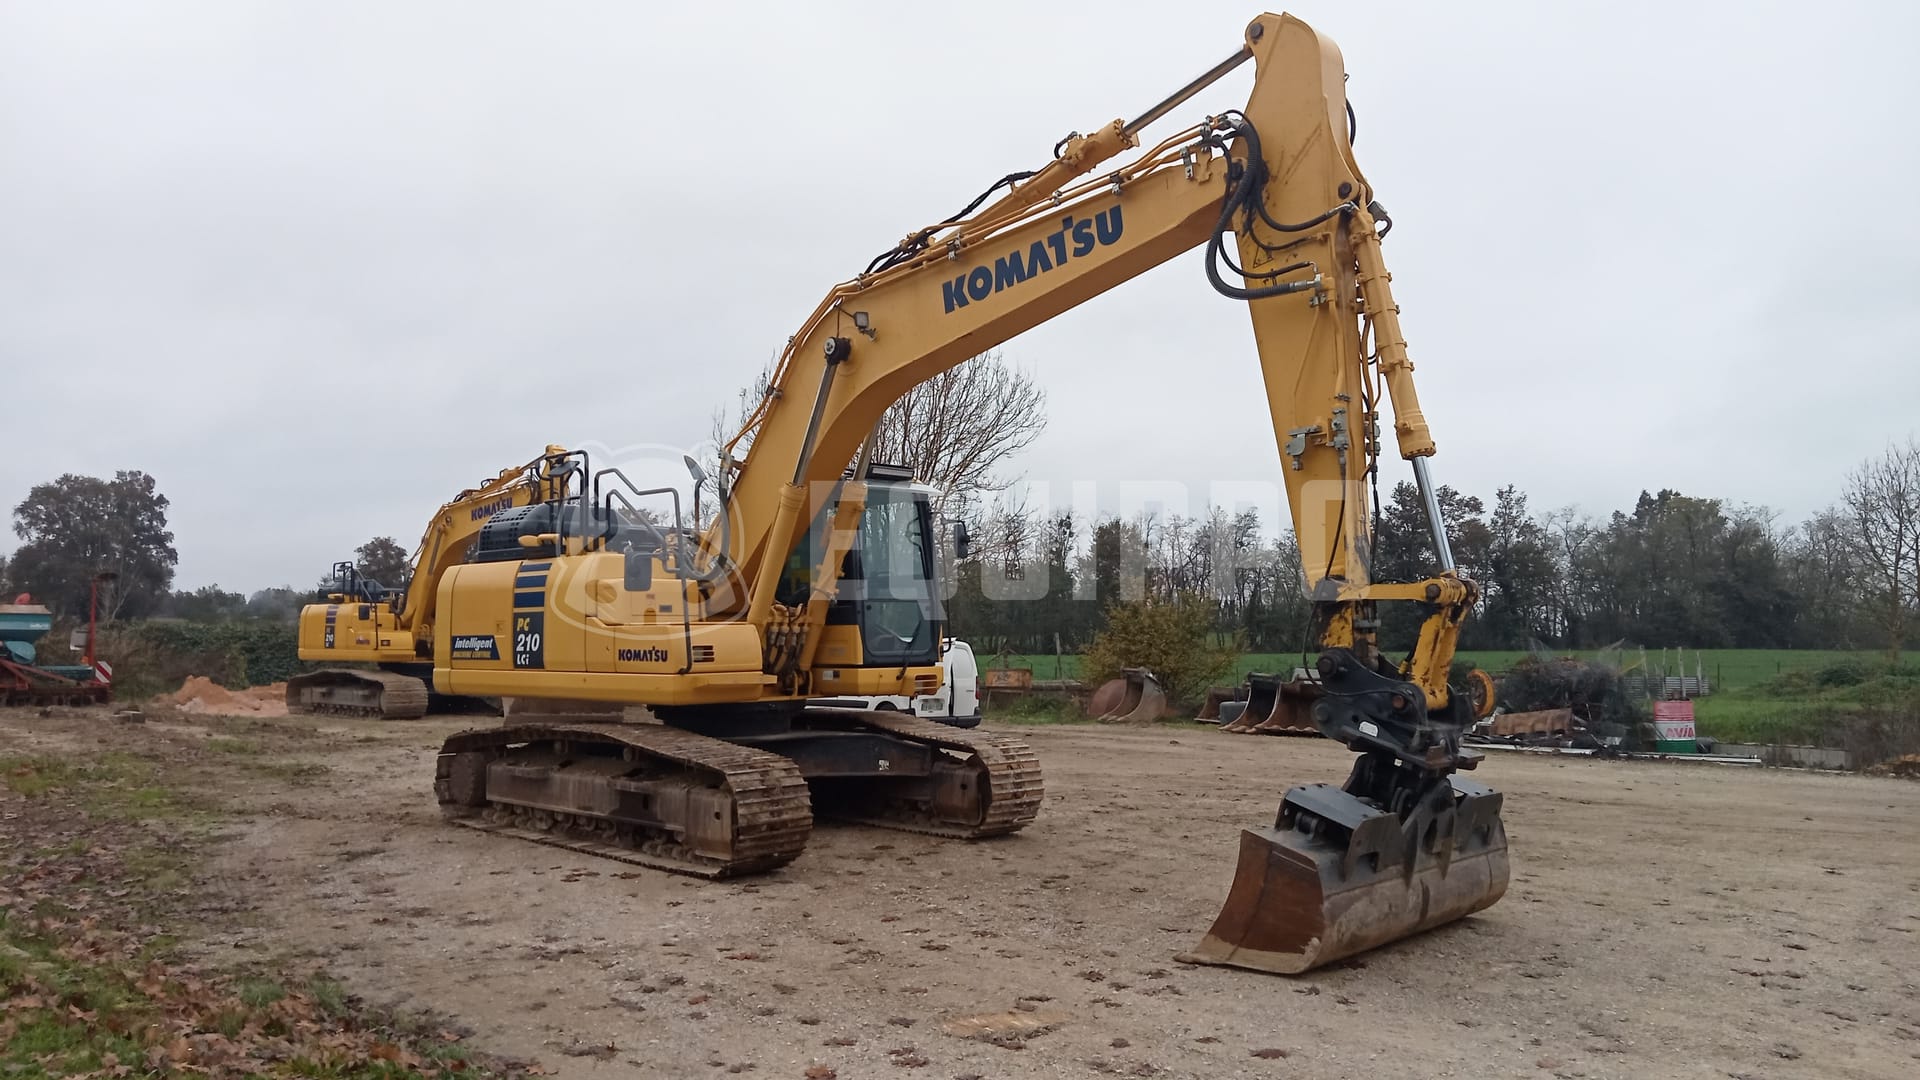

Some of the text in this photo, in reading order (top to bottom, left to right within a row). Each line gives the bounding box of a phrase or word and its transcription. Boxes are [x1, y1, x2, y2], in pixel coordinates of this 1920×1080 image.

[942, 204, 1124, 314] KOMATSU
[471, 496, 513, 521] KOMATSU
[516, 618, 530, 631] PC
[455, 637, 493, 650] intelligent
[516, 633, 540, 652] 210
[618, 645, 668, 662] KOMATSU
